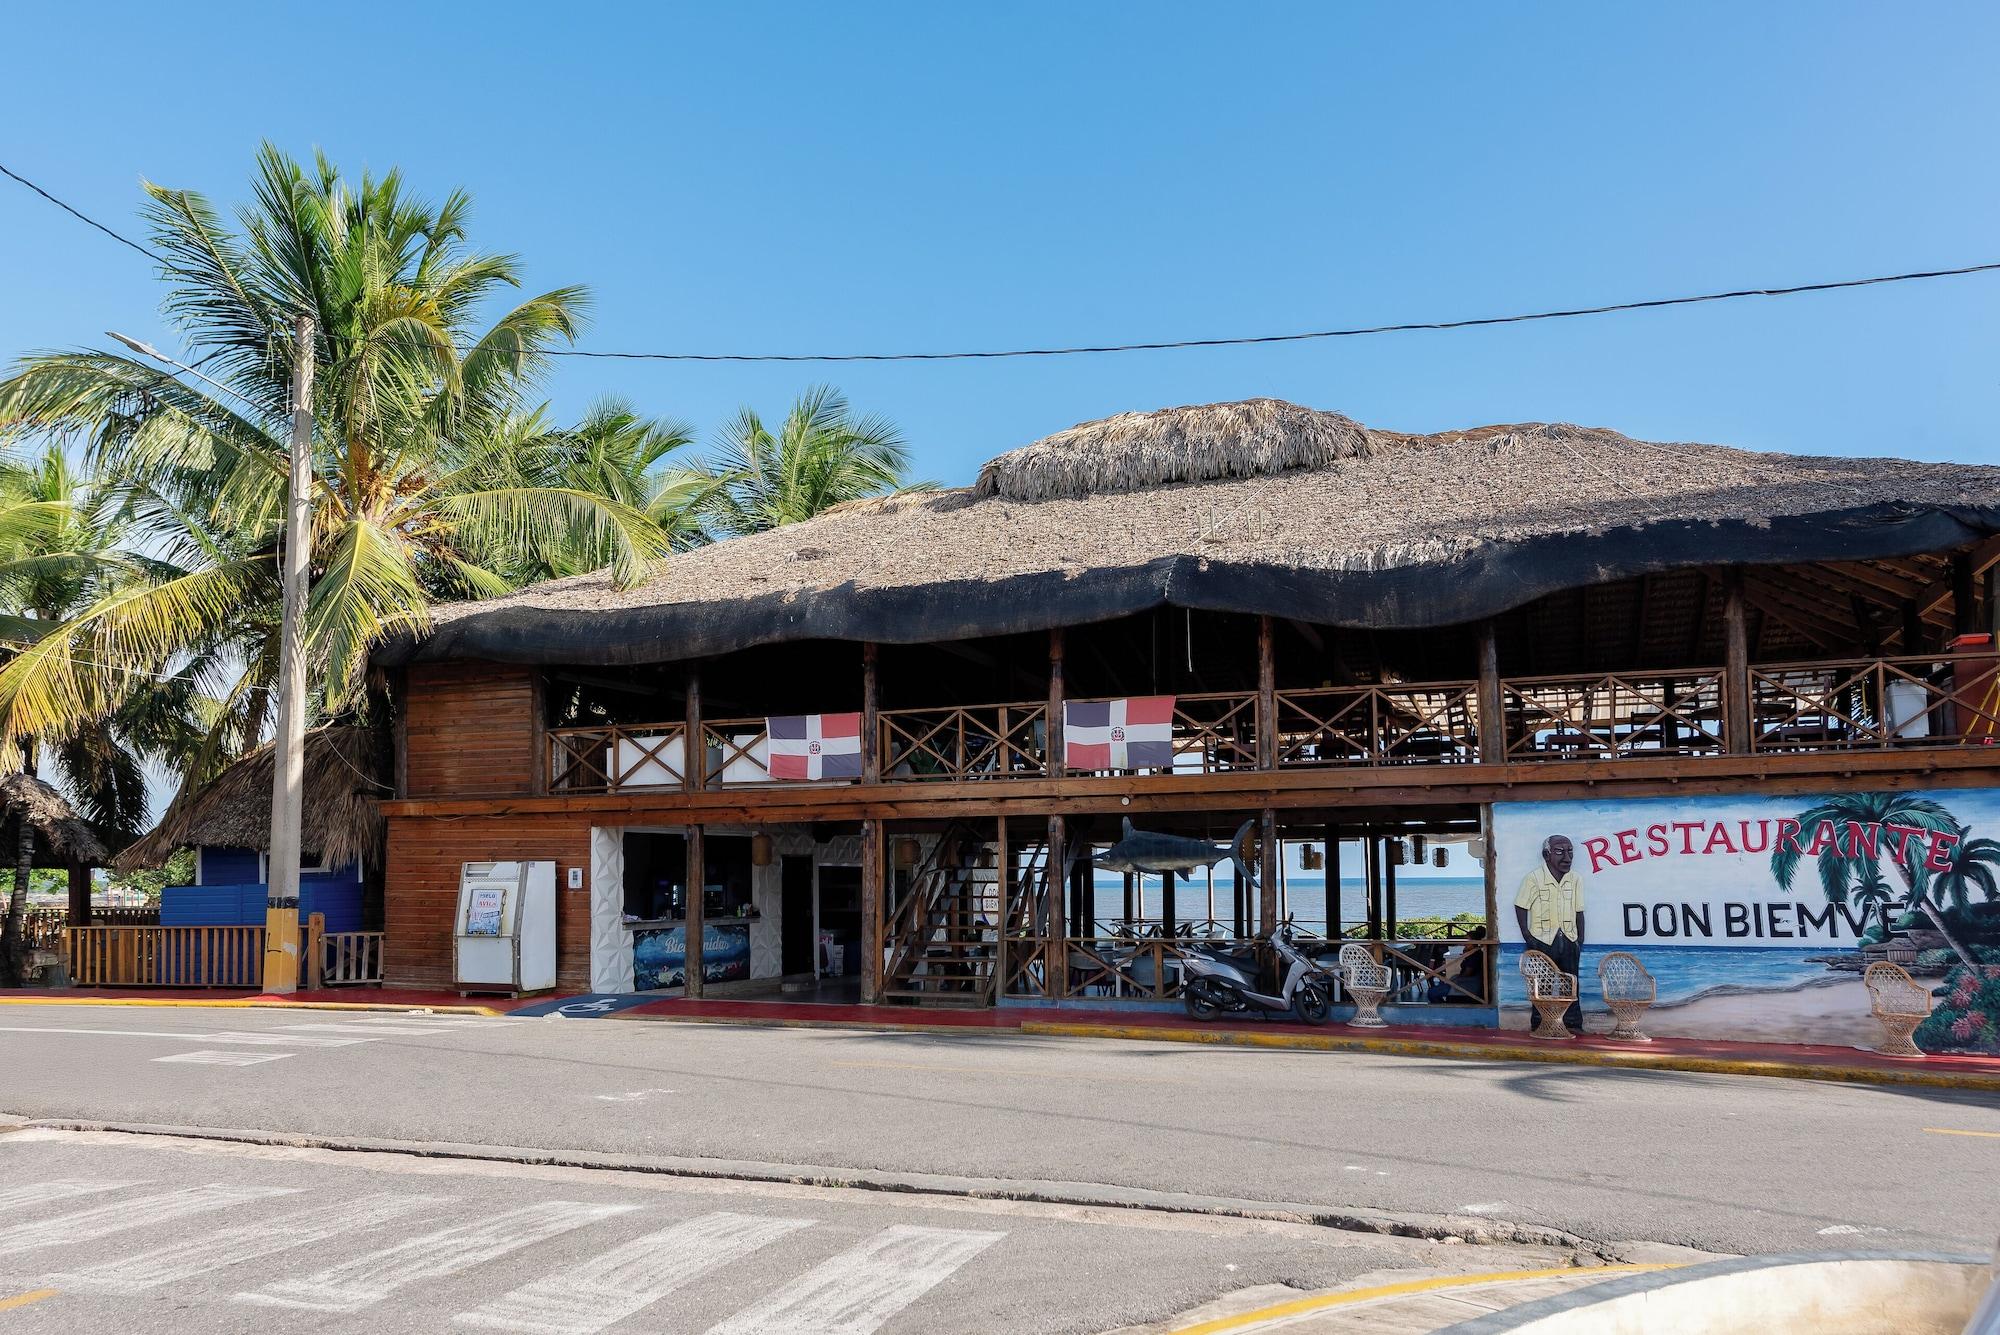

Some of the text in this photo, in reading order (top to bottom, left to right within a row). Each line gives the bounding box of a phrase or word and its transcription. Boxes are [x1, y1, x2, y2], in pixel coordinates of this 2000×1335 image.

[1581, 819, 1960, 874] RESTAURANTE
[1622, 901, 1909, 938] DON BIEMVE
